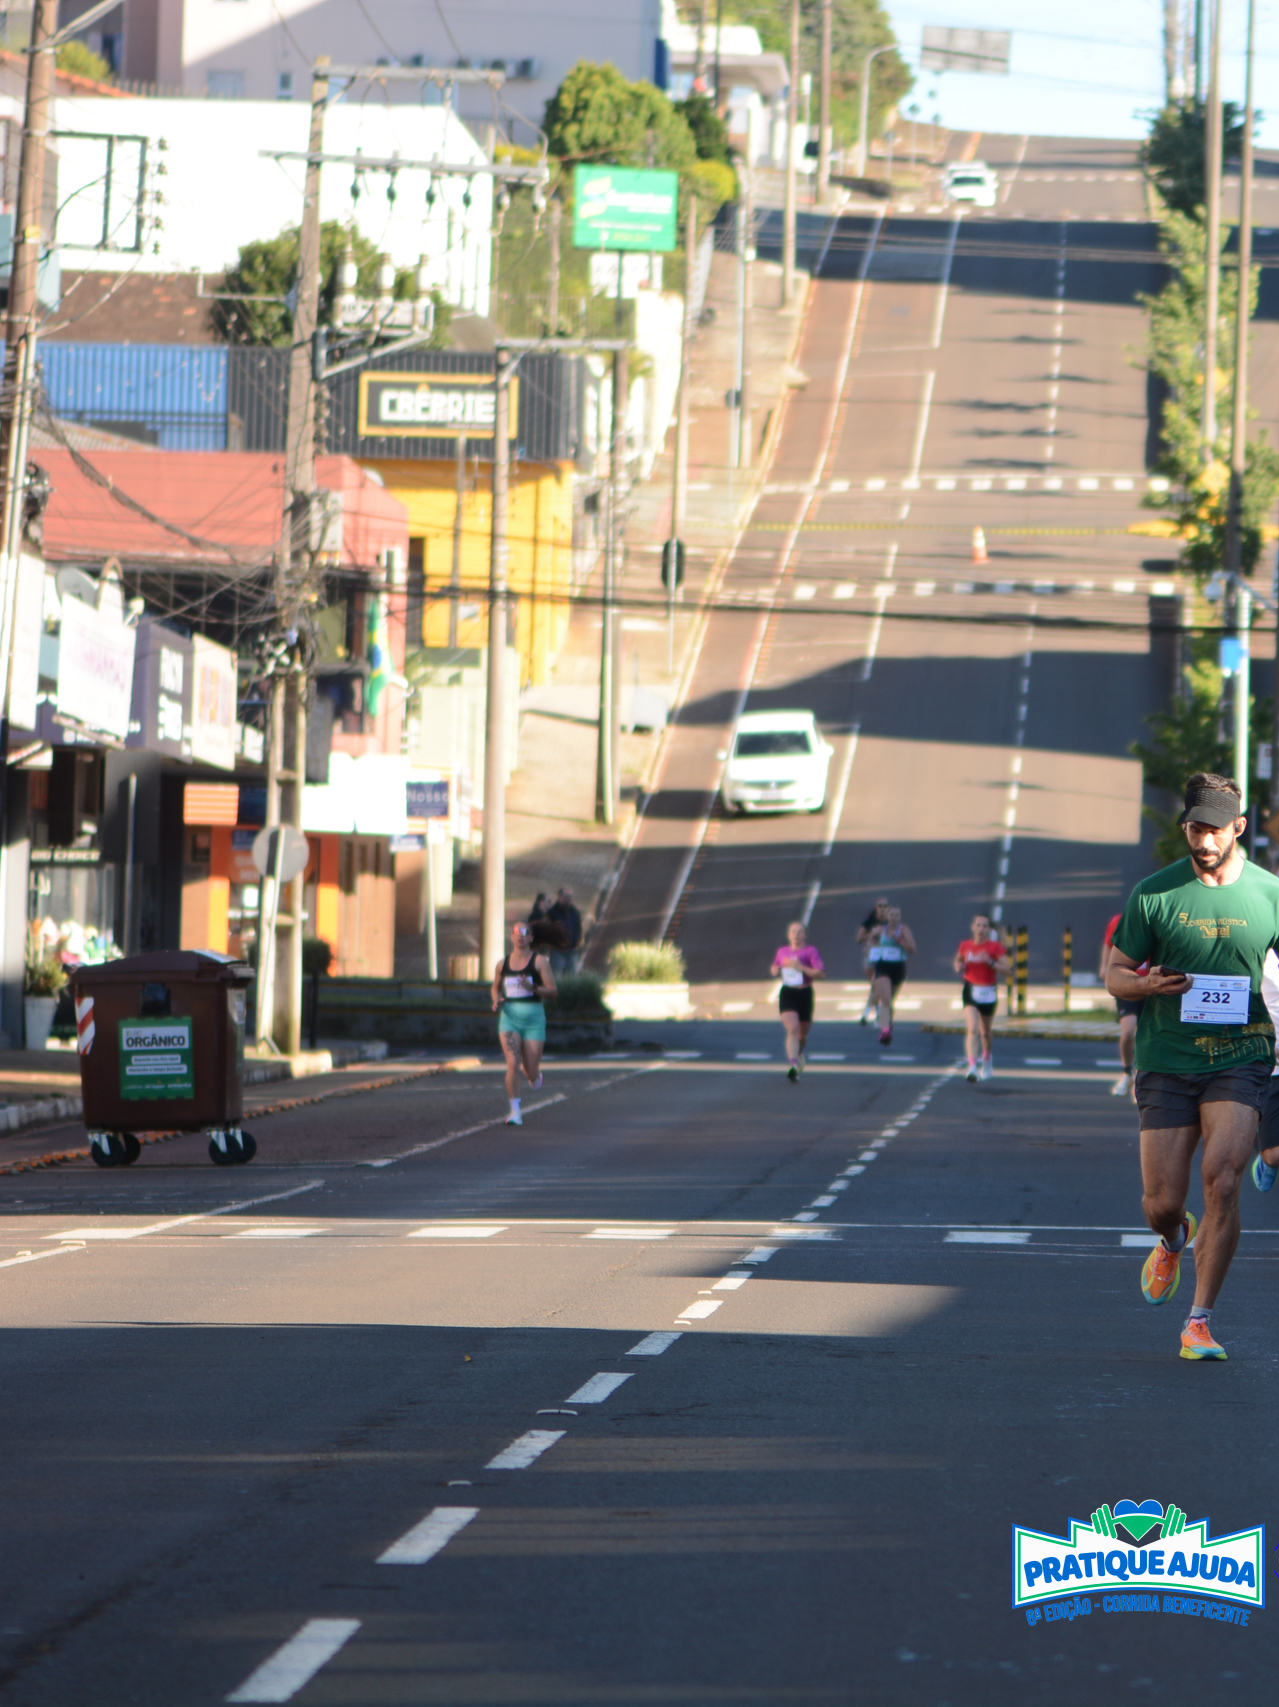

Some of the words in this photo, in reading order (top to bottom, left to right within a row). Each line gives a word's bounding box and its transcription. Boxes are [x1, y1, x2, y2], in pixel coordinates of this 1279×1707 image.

[1218, 917, 1248, 927] RÚSTICA
[1199, 925, 1230, 936] Natal
[1202, 991, 1231, 1004] 232
[126, 1033, 186, 1048] ORGÂNICO
